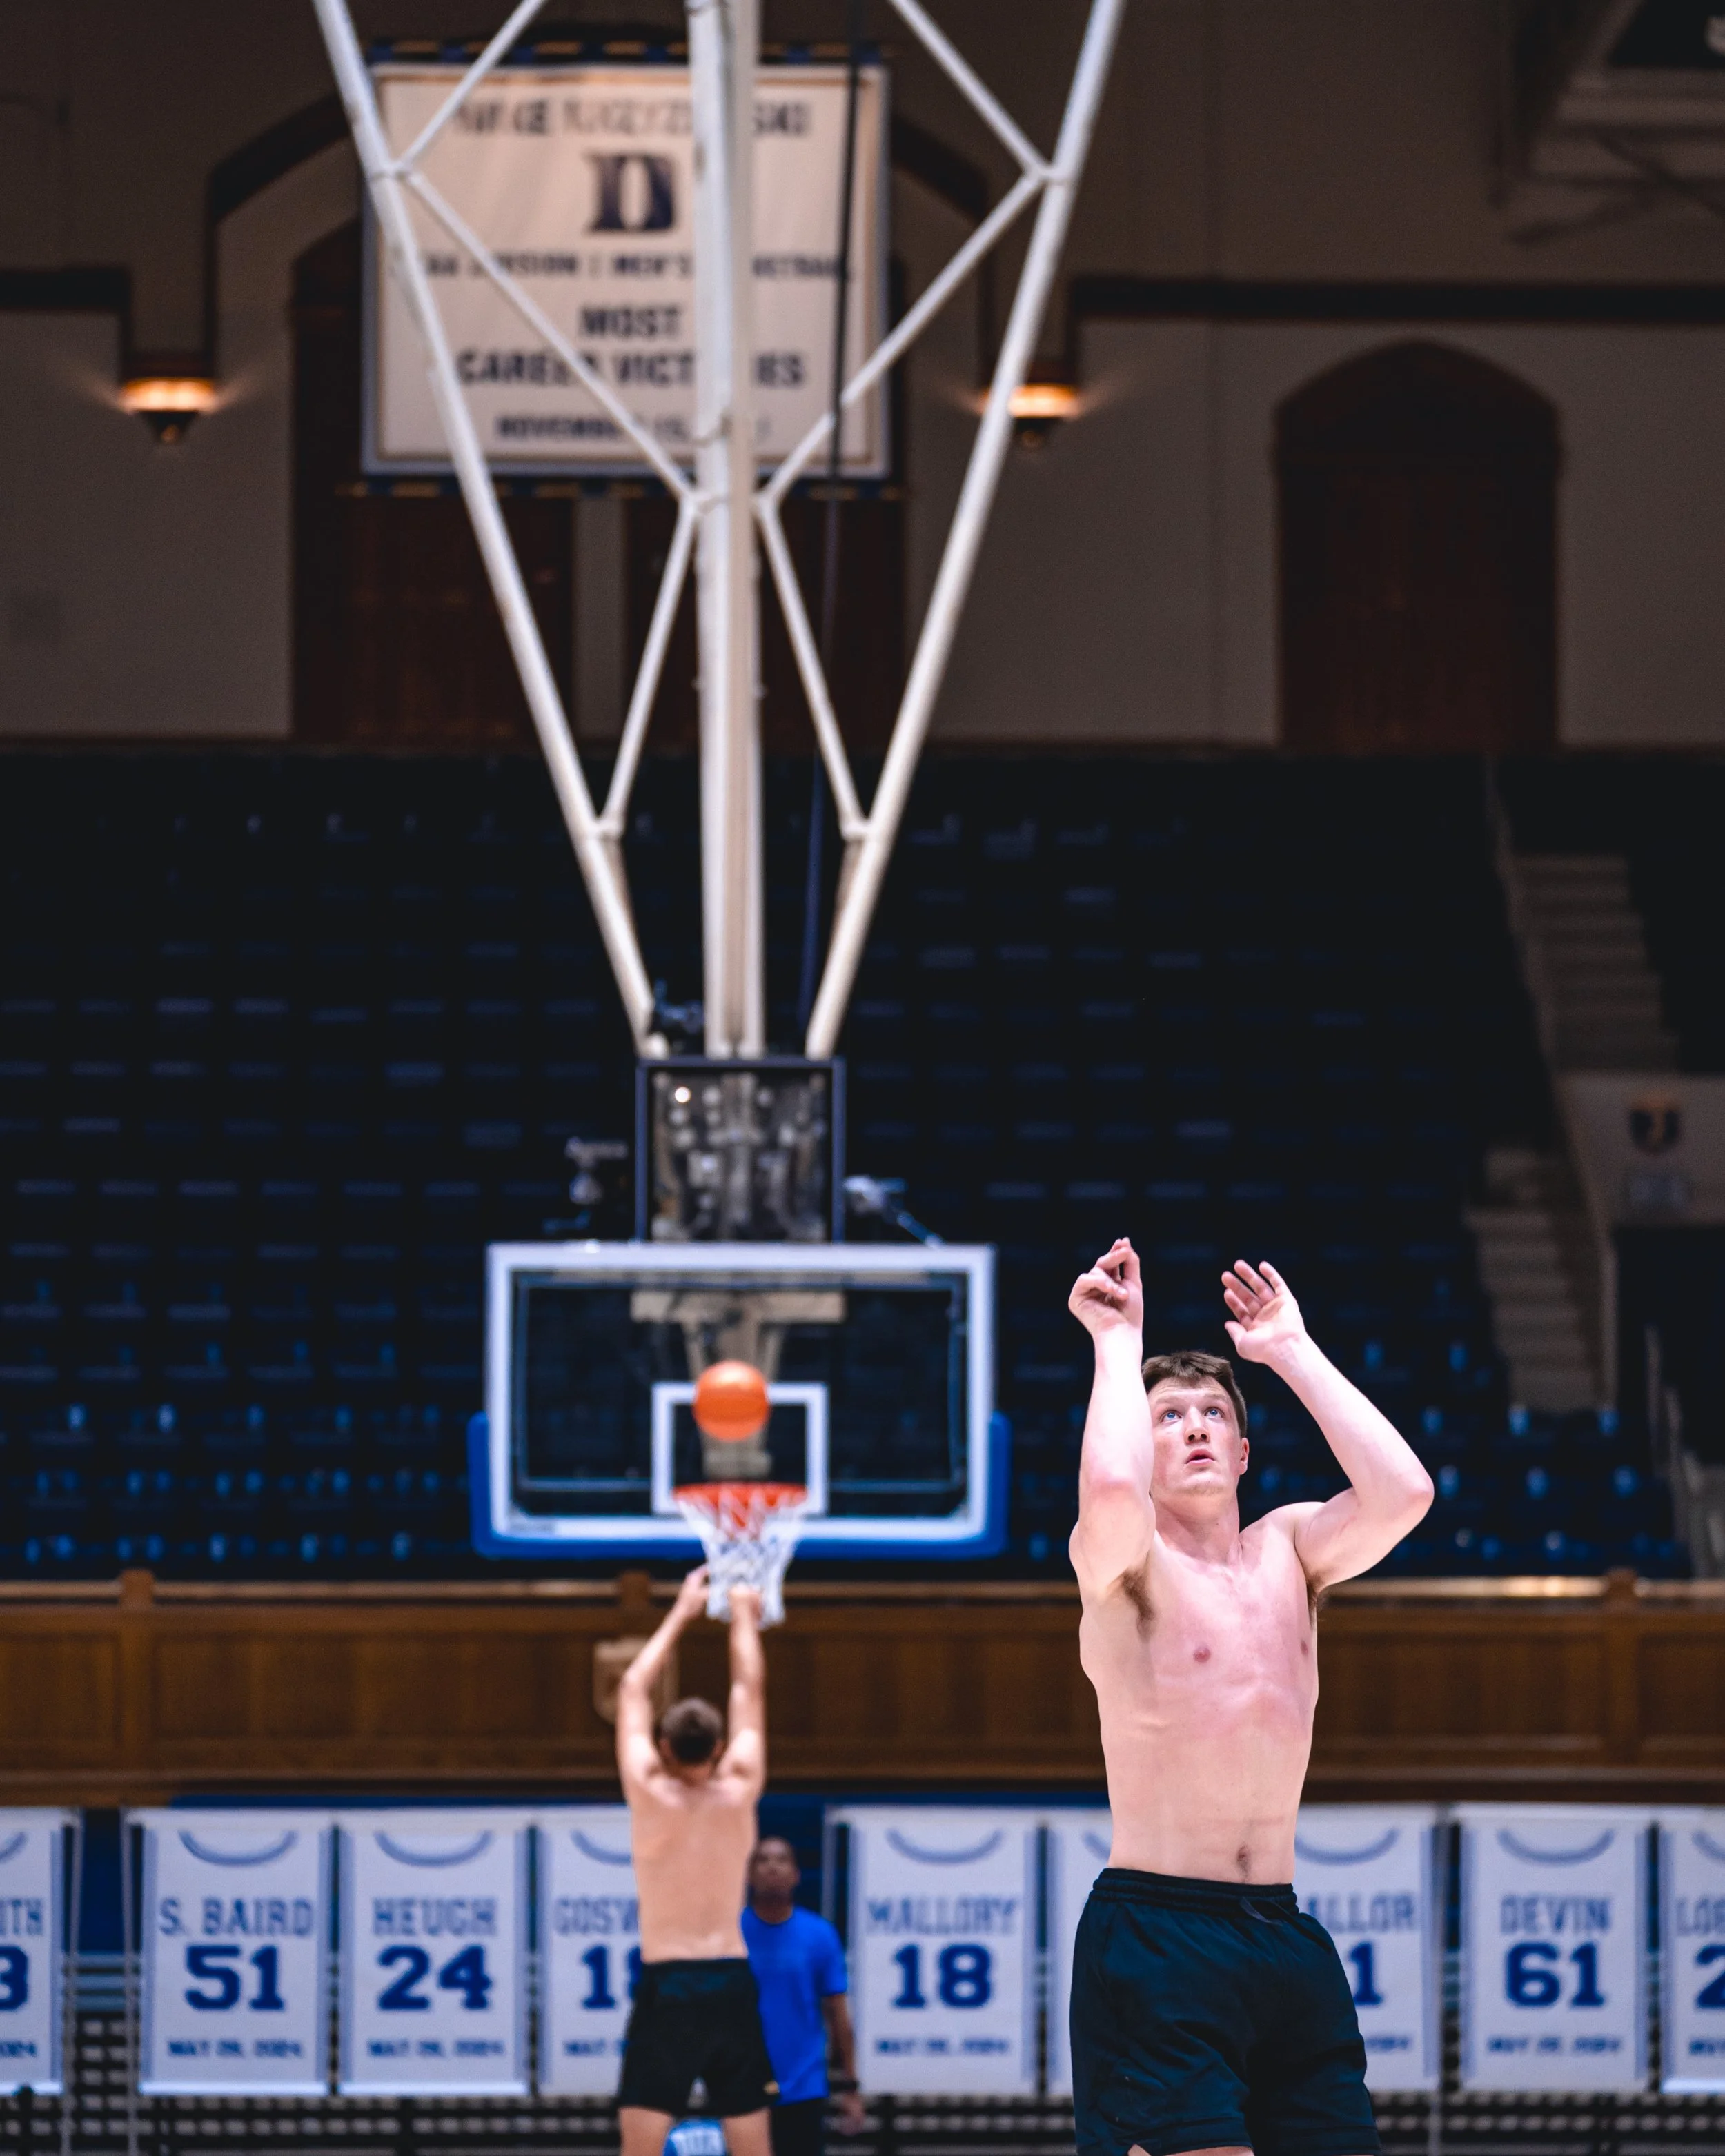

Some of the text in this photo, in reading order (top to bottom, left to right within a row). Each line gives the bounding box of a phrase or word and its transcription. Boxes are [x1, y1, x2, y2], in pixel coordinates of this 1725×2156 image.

[585, 150, 678, 235] D
[580, 306, 681, 338] MOST
[203, 1898, 313, 1935] BAIRD
[372, 1898, 497, 1935] HEUGH
[867, 1896, 1018, 1935] MALLORY
[1499, 1896, 1611, 1935] DEVIN
[184, 1945, 285, 2010] 51
[377, 1945, 493, 2010] 24
[894, 1944, 992, 2009] 18
[1506, 1942, 1604, 2008] 61
